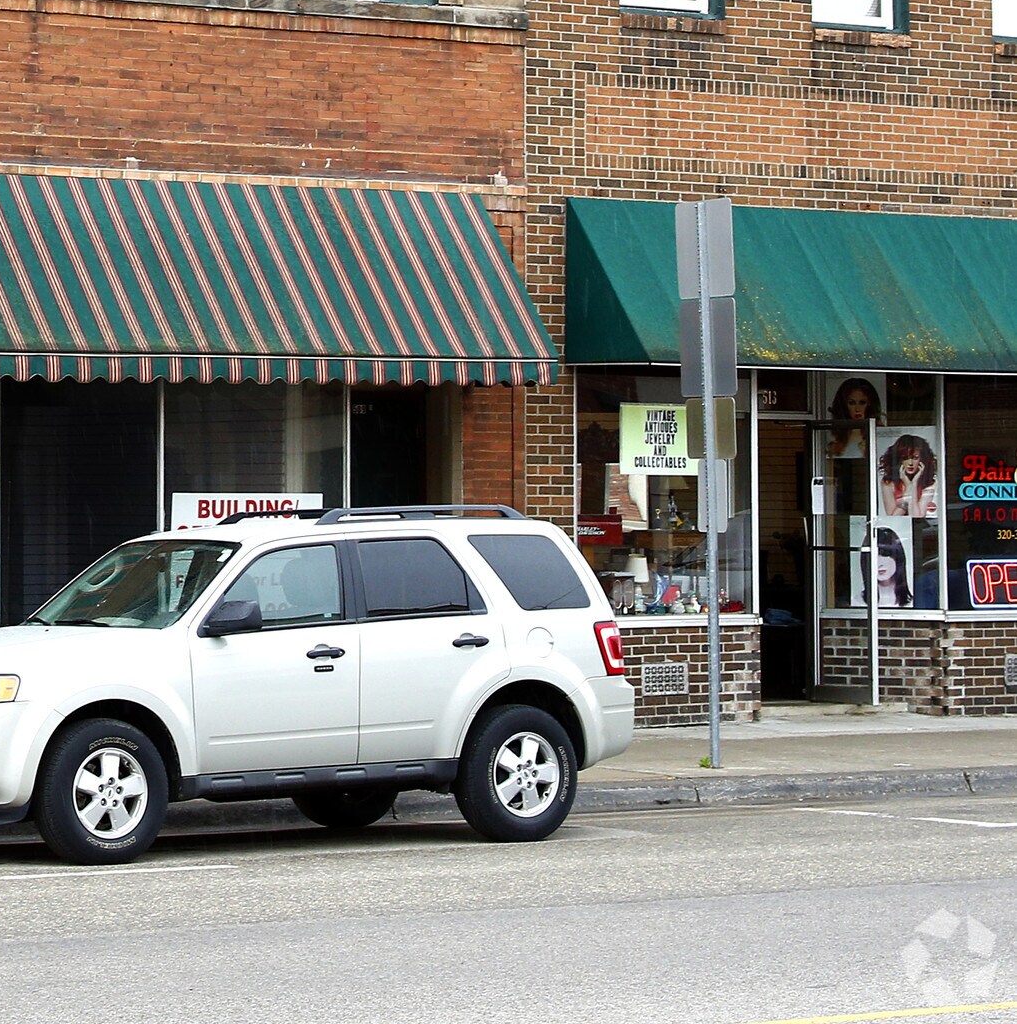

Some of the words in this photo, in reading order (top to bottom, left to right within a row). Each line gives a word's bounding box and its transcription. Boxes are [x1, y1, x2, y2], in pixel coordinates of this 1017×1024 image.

[762, 390, 777, 404] 513
[646, 410, 676, 422] VINTAGE
[645, 422, 678, 433] ANTIQUES
[645, 434, 675, 445] JEWELRY
[653, 445, 667, 456] AND
[634, 457, 687, 468] COLLECTABLES
[963, 456, 1014, 482] Hair
[962, 485, 1017, 498] CONN
